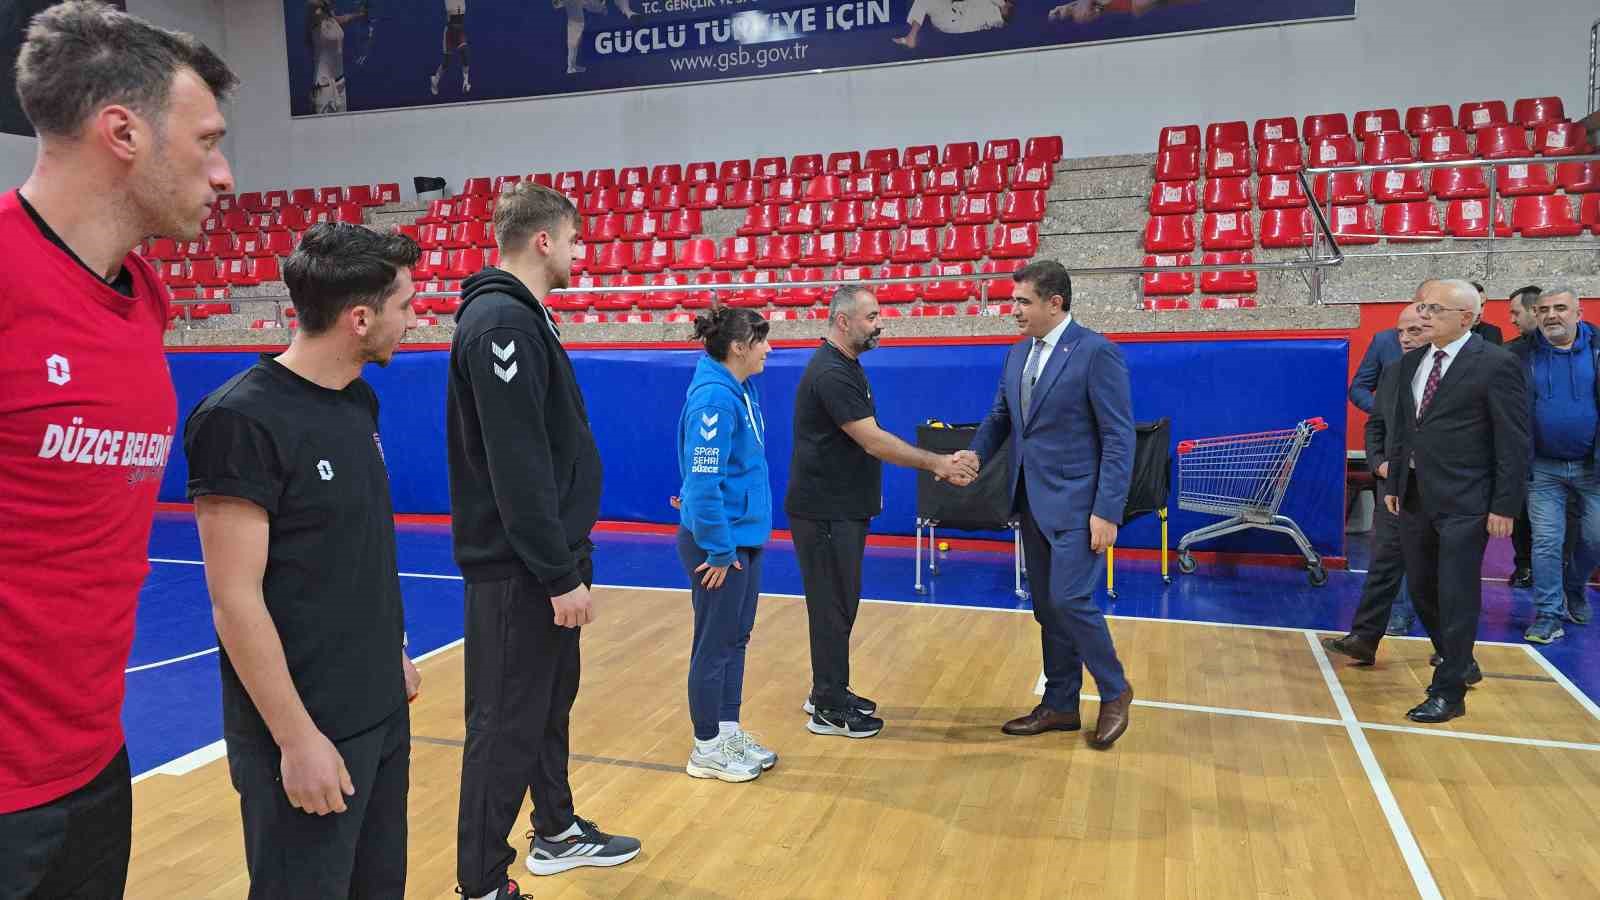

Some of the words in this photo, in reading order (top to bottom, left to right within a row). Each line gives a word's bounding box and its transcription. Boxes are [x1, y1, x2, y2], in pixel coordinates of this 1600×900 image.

[642, 2, 662, 14] T.C.
[594, 25, 686, 55] GÜÇLÜ
[825, 0, 890, 30] İÇİN
[670, 42, 809, 72] www.gsb.gov.tr
[38, 416, 123, 466] DÜZCE
[120, 426, 174, 467] BELEDİ
[694, 447, 720, 456] SPOR
